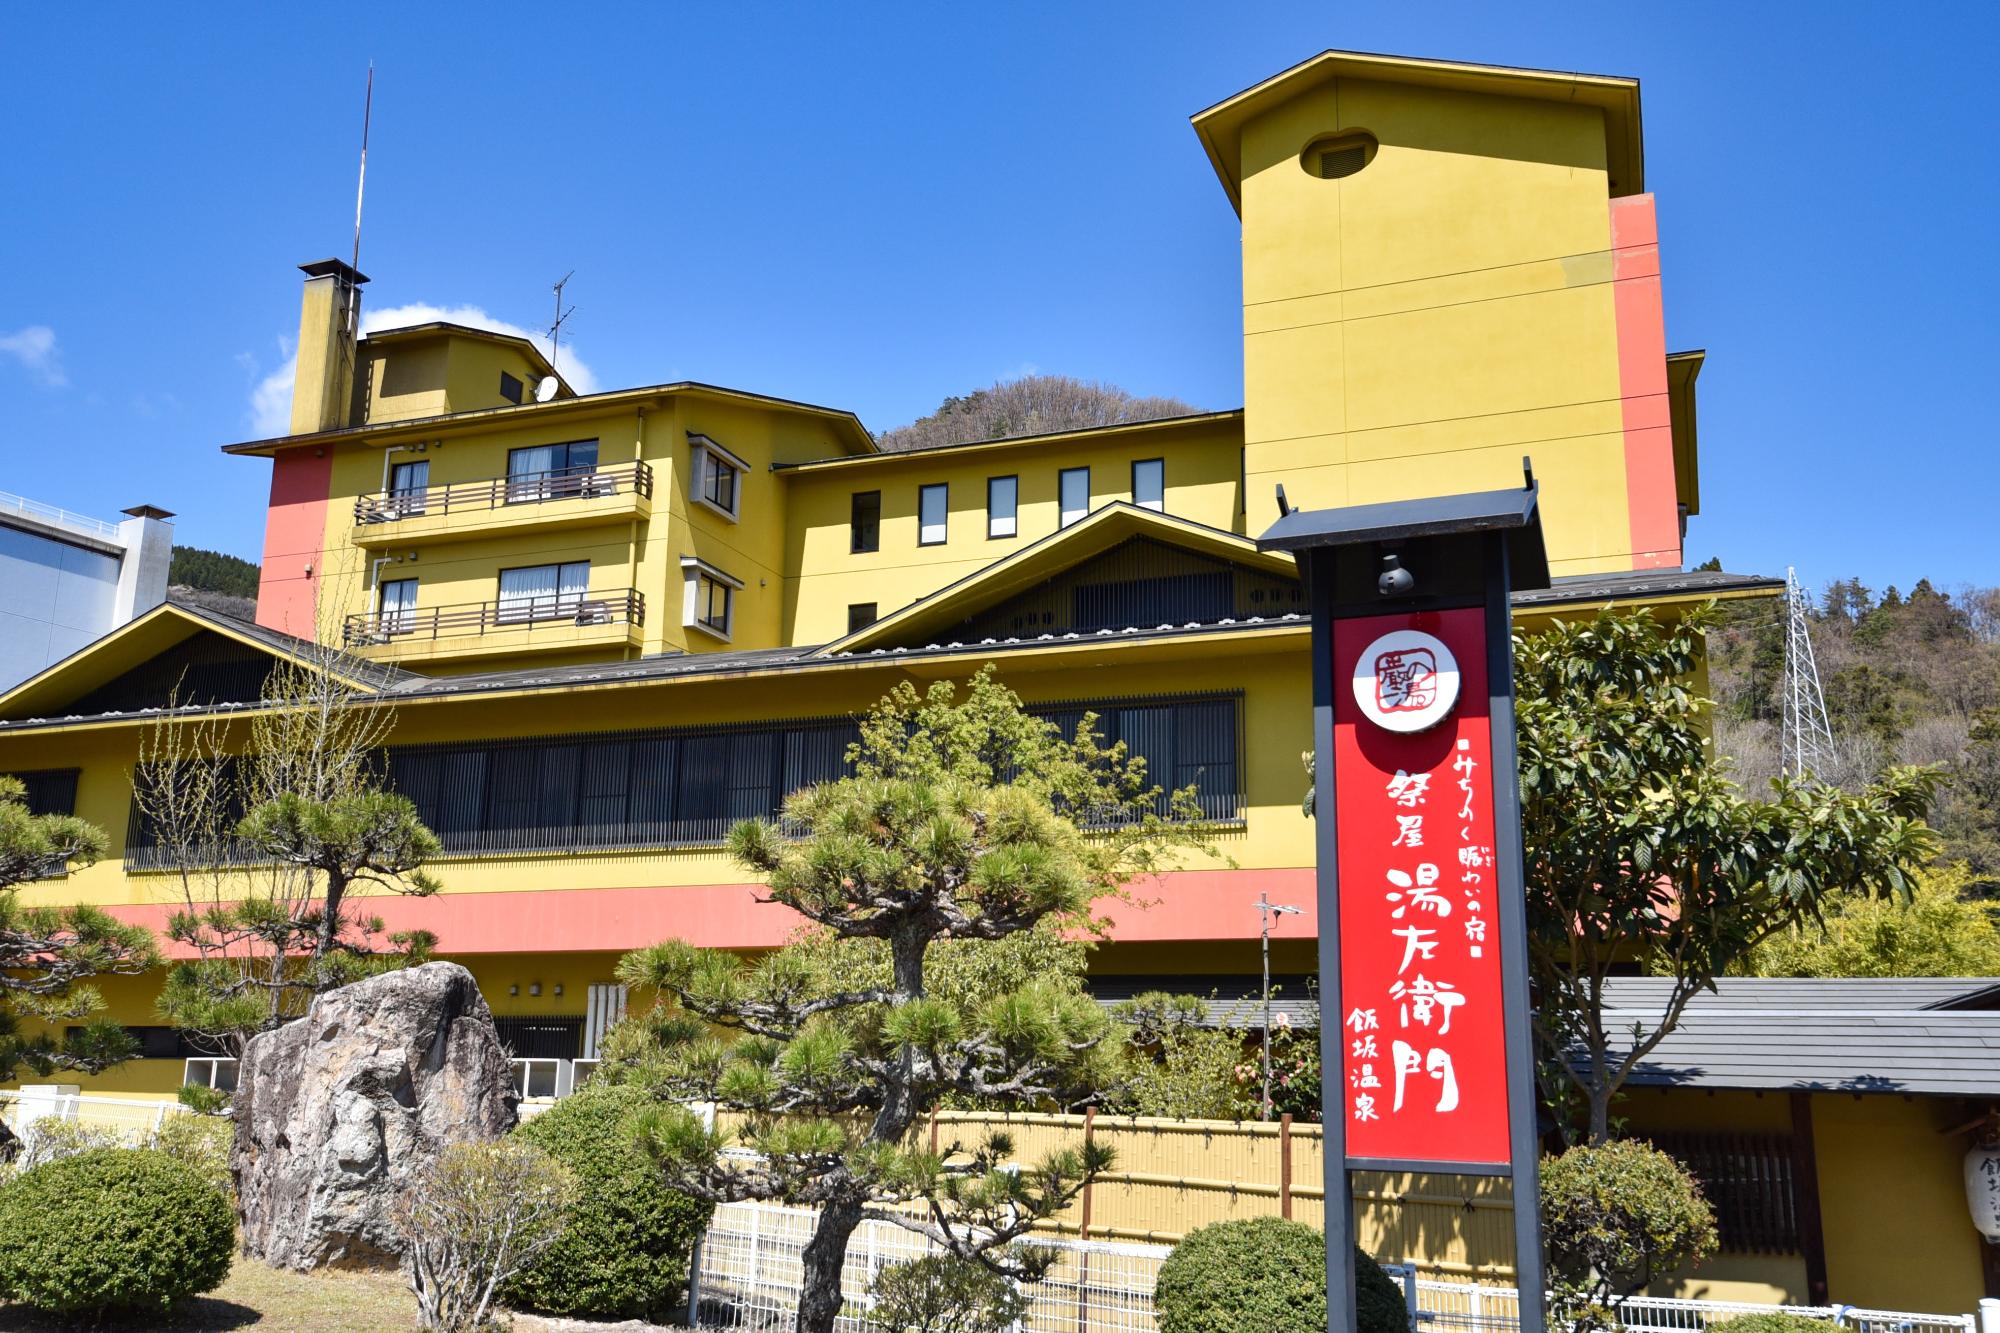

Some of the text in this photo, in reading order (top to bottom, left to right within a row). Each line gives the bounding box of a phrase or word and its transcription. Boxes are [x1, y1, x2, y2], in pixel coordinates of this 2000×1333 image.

[1385, 769, 1466, 1113] 祭屋湯左衛門
[1346, 1007, 1382, 1122] 飯坂温泉
